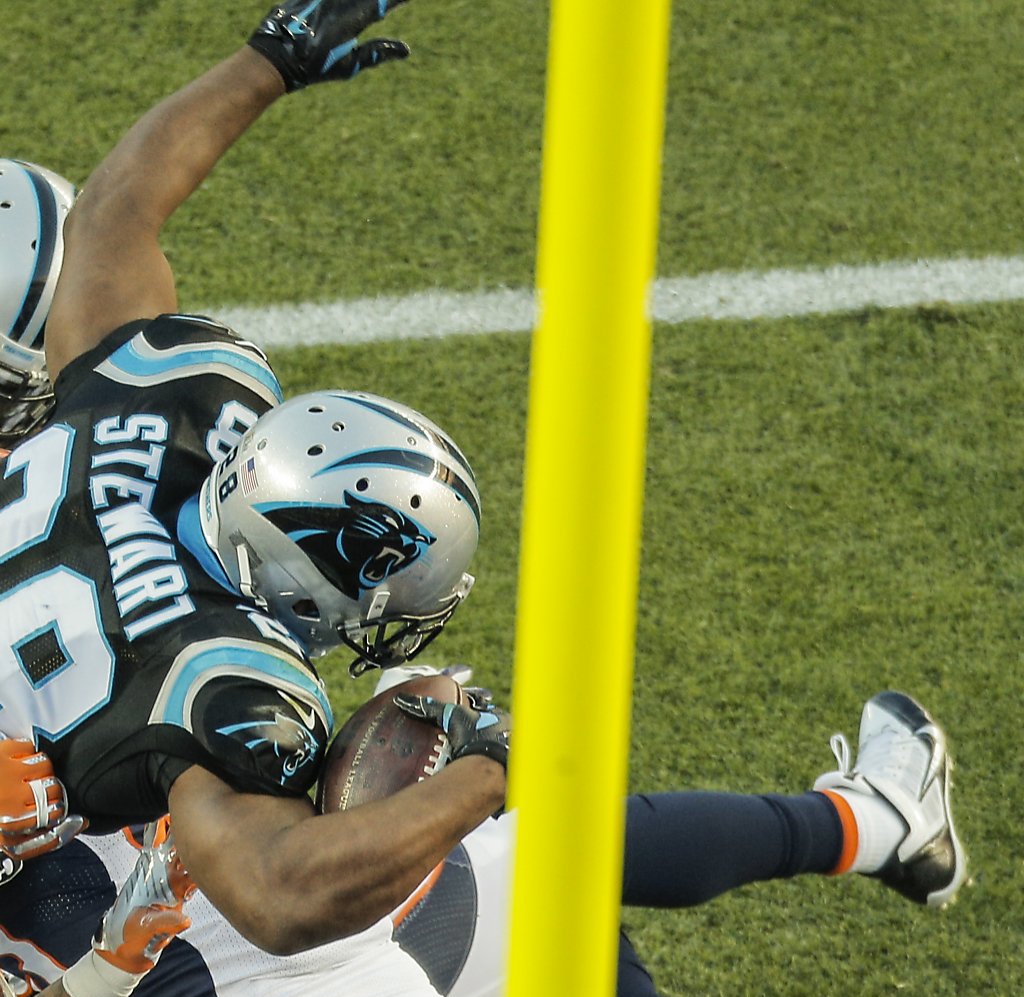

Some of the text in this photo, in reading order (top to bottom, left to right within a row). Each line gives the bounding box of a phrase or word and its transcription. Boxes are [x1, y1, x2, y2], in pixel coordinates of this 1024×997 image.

[205, 399, 260, 464] 8
[218, 445, 238, 504] 28
[91, 413, 196, 643] STEWART
